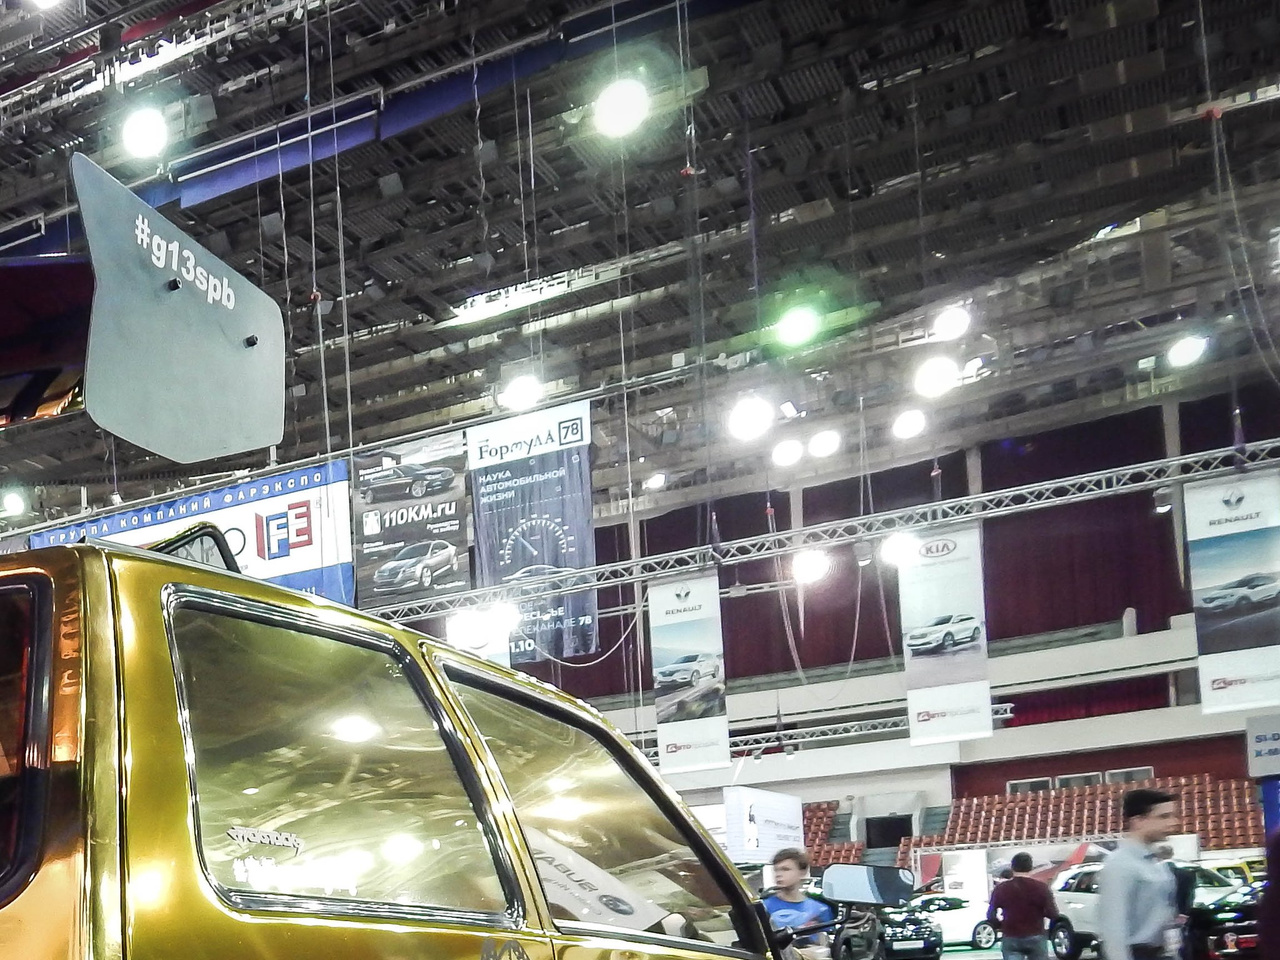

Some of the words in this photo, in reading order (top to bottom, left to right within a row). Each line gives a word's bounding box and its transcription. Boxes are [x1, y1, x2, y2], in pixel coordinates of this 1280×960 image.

[135, 214, 235, 310] #g13spb
[561, 422, 580, 440] 78
[479, 470, 512, 483] НАУКА
[480, 467, 566, 493] АВТОМОБИЛЬНОЙ
[480, 490, 515, 504] ЖИЗНИ
[49, 524, 110, 544] ГРУППА
[120, 497, 212, 527] КОМПАНИЙ
[224, 472, 322, 504] ФАРЭКСПО
[1209, 511, 1261, 526] RENAULT
[925, 542, 950, 555] KIA
[665, 604, 702, 615] RENAULT
